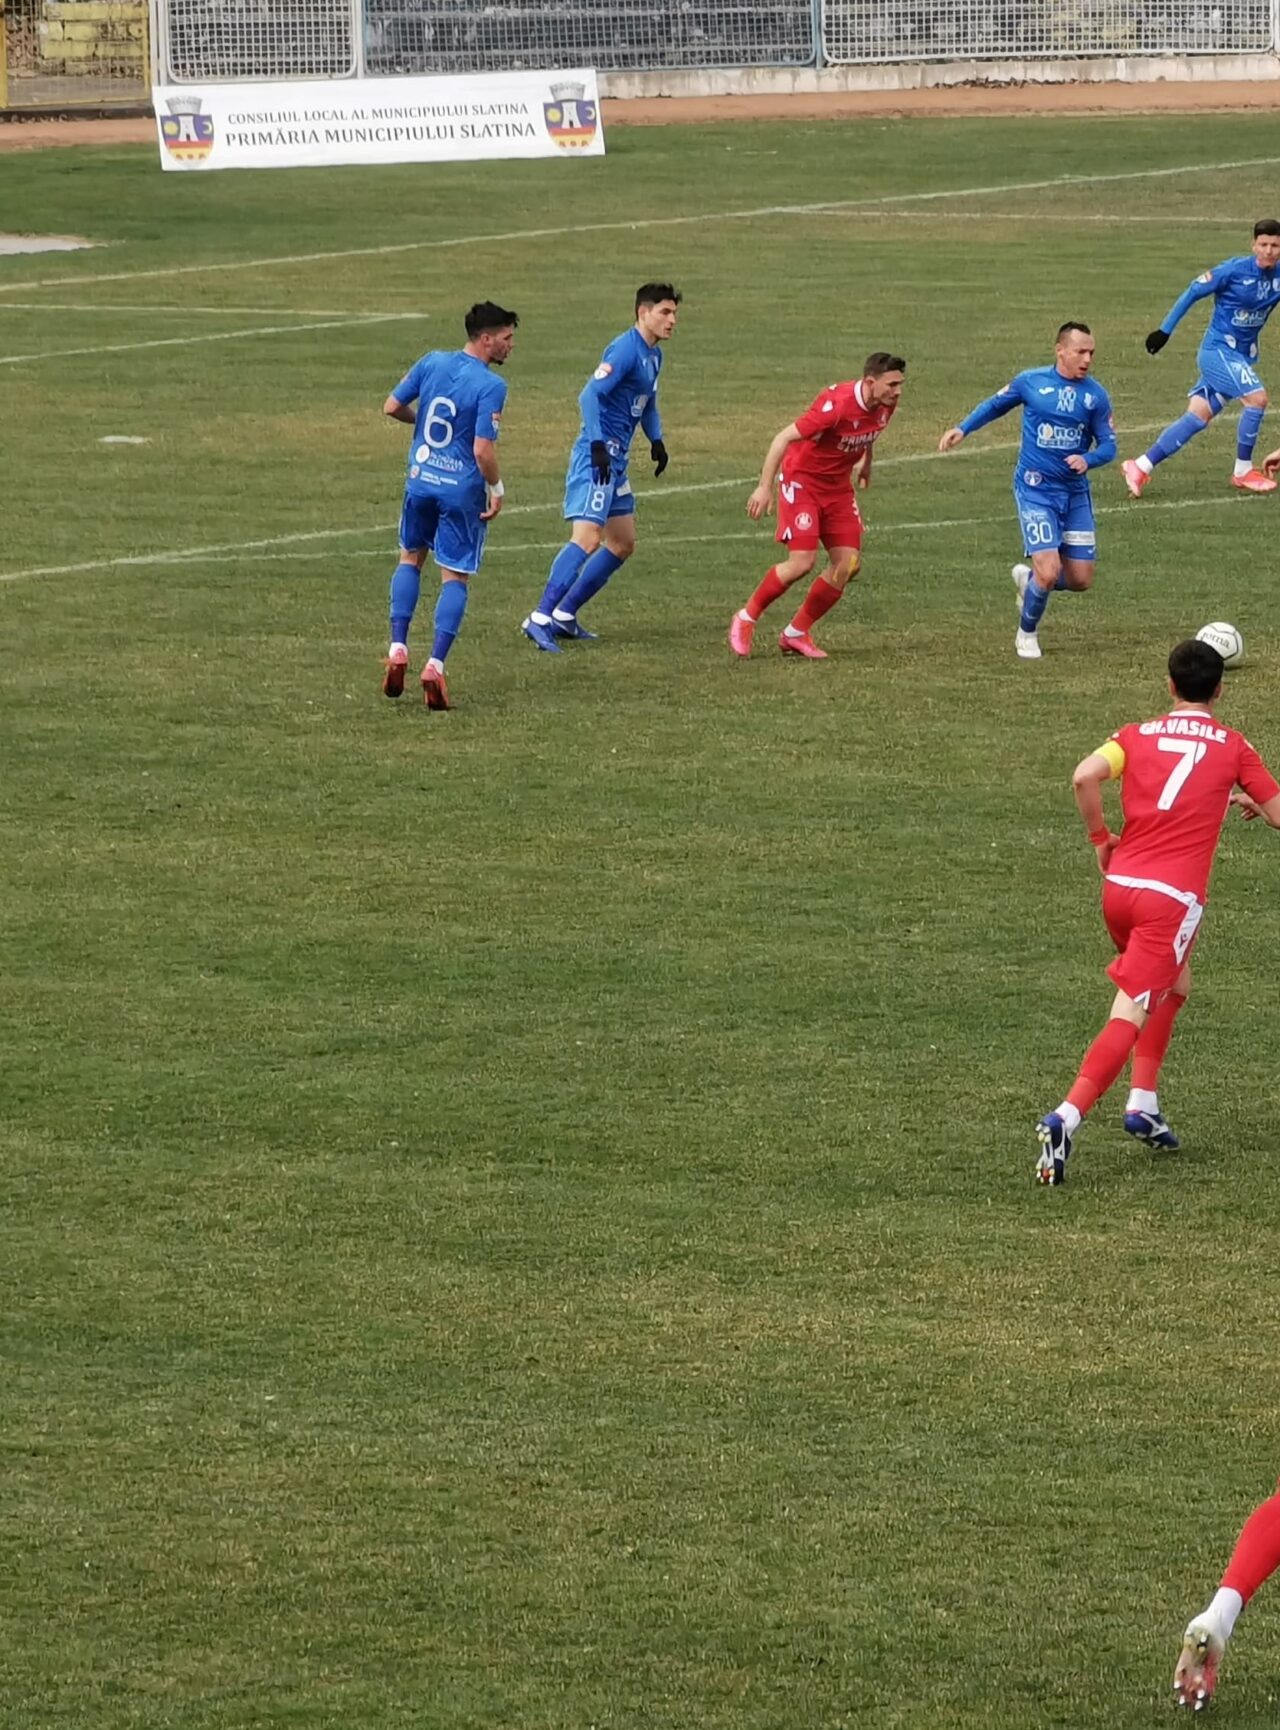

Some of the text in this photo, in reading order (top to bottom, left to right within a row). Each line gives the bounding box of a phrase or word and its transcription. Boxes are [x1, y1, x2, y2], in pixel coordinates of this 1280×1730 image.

[228, 103, 529, 125] CONSILIUL LOCAL AL MUNICIPIULUI SLATINA
[226, 121, 536, 147] PRIMĂRIA MUNICIPIULUI SLATINA
[1056, 400, 1075, 413] ANI
[423, 396, 457, 448] 6
[591, 490, 606, 512] 8
[1026, 521, 1053, 545] 30
[1139, 718, 1227, 744] GH.VASILE
[1157, 737, 1208, 810] 7
